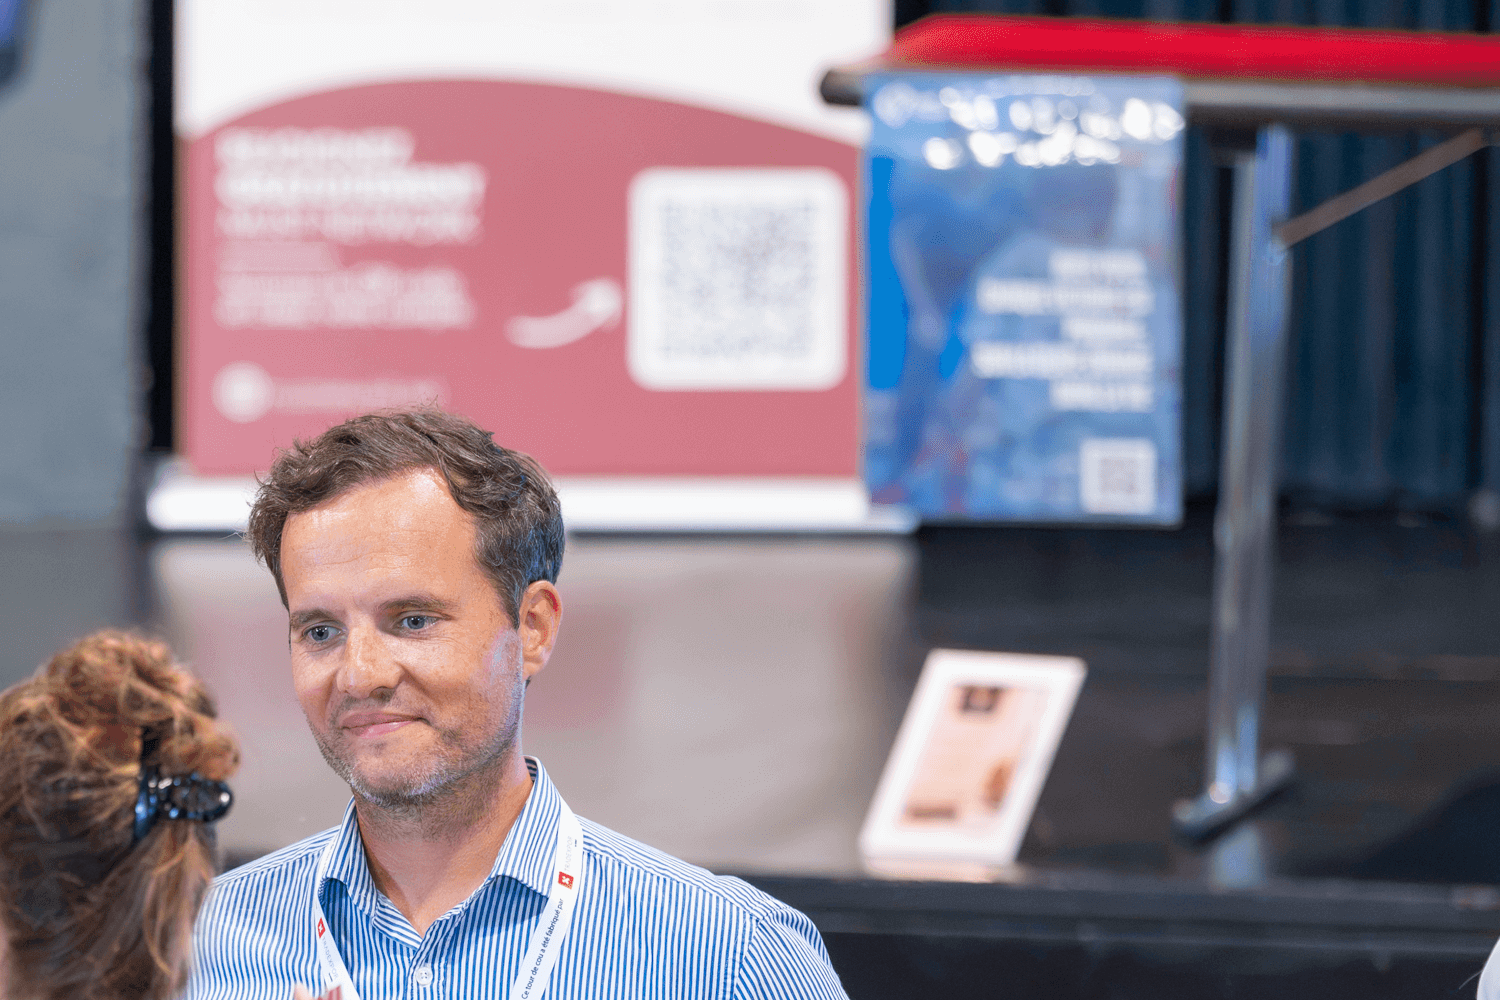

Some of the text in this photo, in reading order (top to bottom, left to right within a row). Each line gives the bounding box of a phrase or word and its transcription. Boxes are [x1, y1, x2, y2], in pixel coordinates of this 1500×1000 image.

[546, 909, 561, 937] fabriqué
[542, 936, 551, 948] été
[535, 954, 544, 966] cou
[531, 966, 539, 976] de
[526, 976, 535, 990] tour
[521, 990, 530, 1000] Ce
